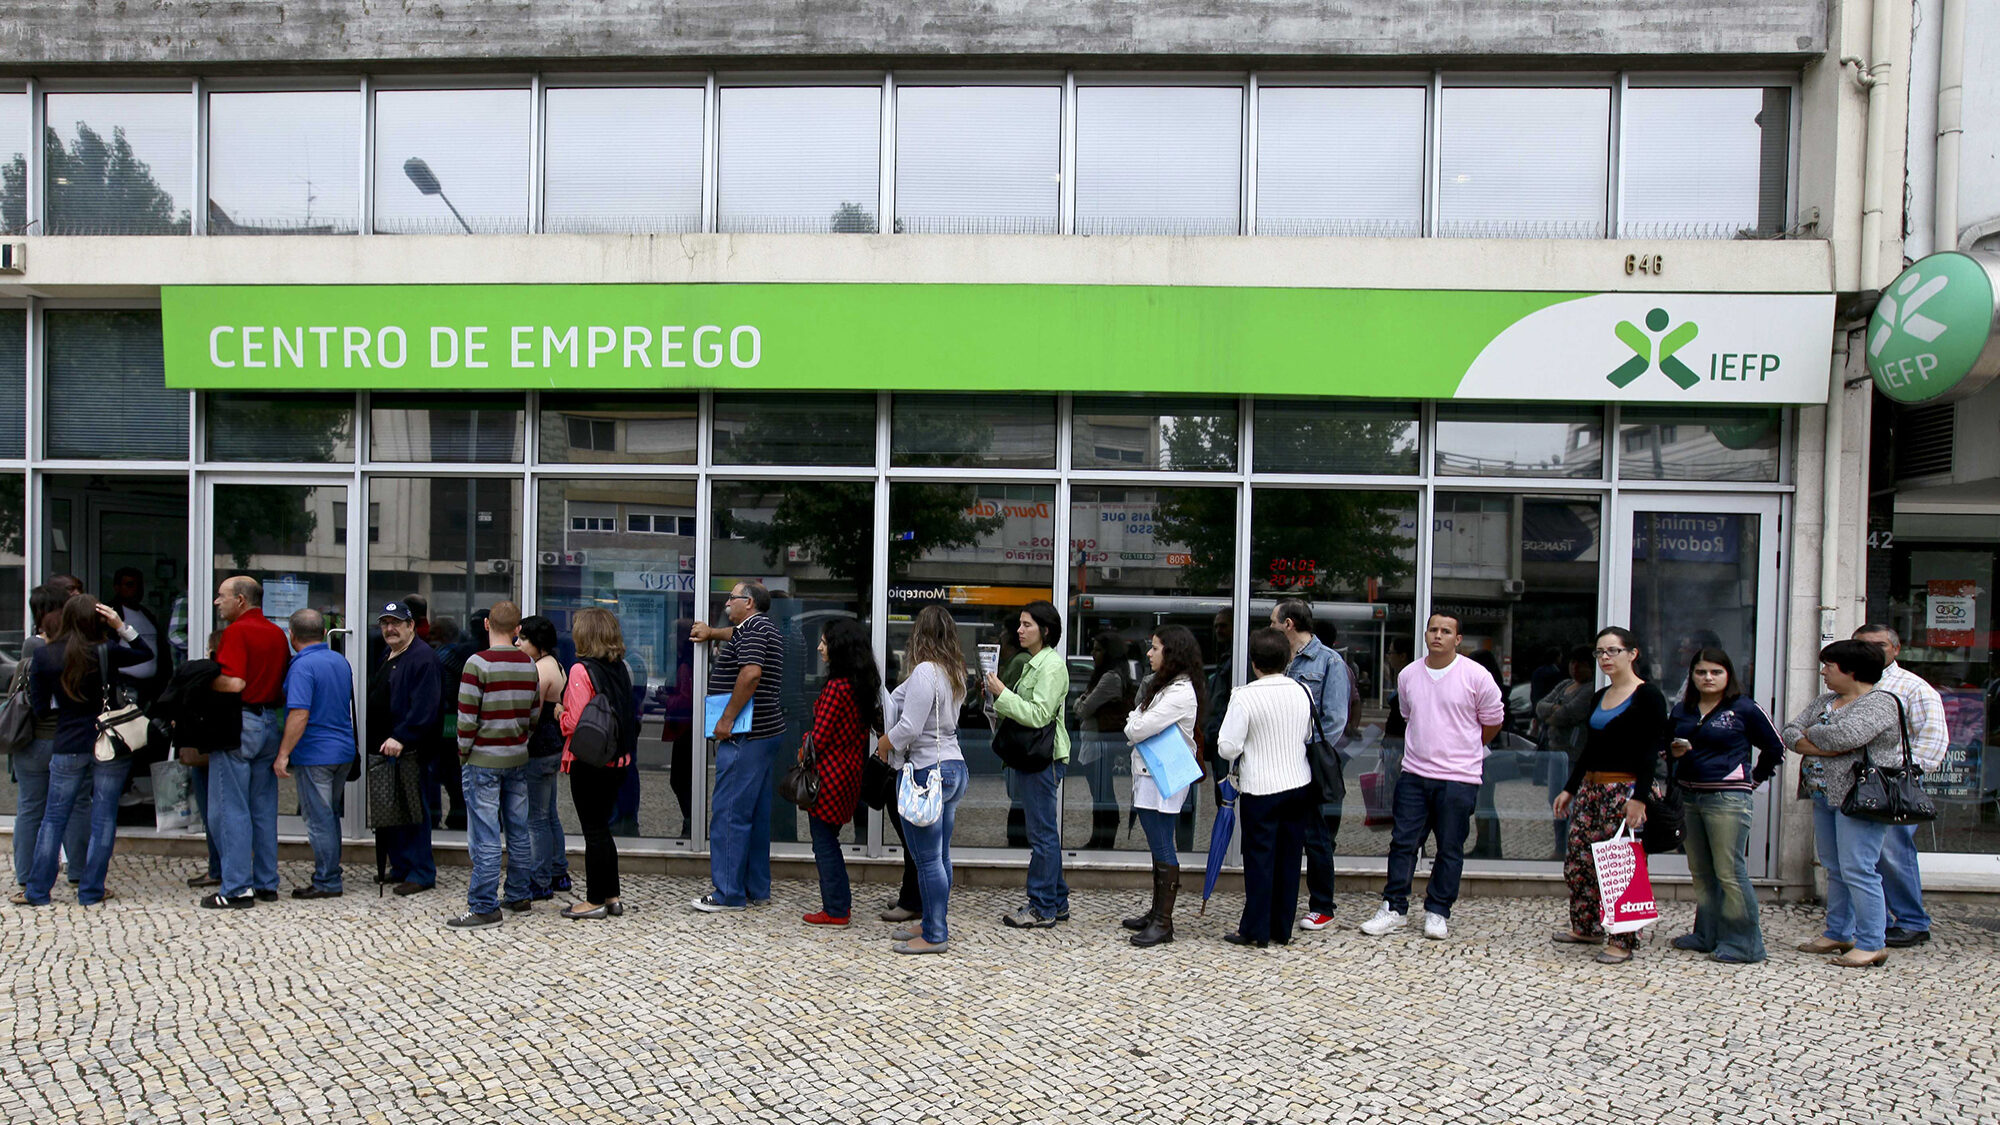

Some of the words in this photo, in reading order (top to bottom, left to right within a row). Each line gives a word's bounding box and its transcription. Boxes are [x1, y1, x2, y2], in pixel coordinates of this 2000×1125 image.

[1624, 254, 1664, 275] 646
[209, 325, 408, 369] CENTRO
[430, 326, 489, 368] DE
[510, 325, 762, 369] EMPREGO
[1709, 353, 1781, 382] IEFP
[1879, 353, 1938, 391] IEFP
[1620, 901, 1655, 914] stara
